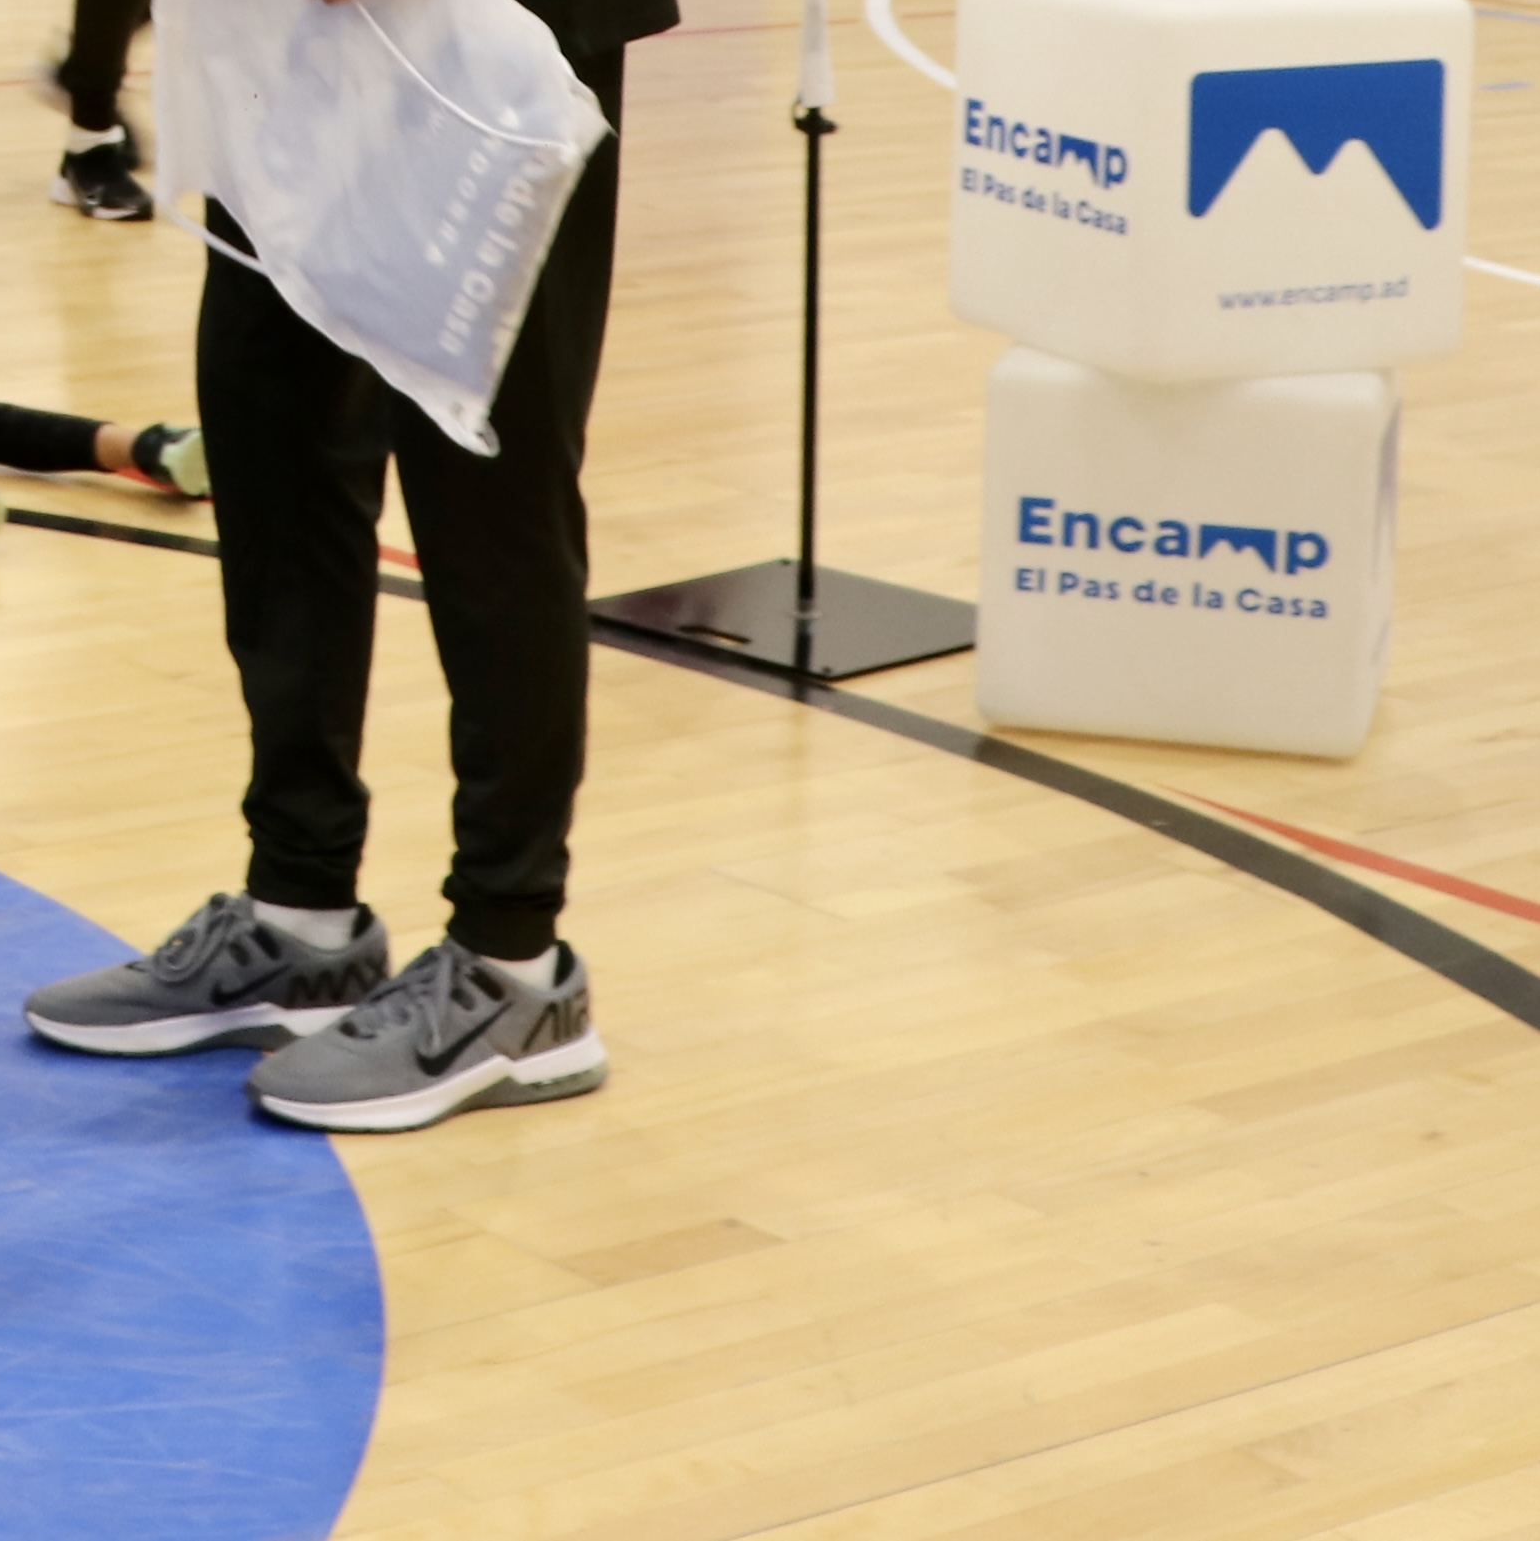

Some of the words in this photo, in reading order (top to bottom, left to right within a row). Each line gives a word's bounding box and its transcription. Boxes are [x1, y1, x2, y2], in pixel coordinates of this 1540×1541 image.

[965, 97, 1128, 190] Encamp
[983, 173, 1016, 204] Pas
[1022, 187, 1046, 212] de
[1076, 199, 1128, 235] Casa
[1018, 496, 1331, 575] Encamp
[1015, 567, 1045, 592] El
[1059, 571, 1121, 600] Pas
[1132, 579, 1179, 605] de
[1192, 581, 1225, 609] la
[1235, 587, 1329, 619] Casa
